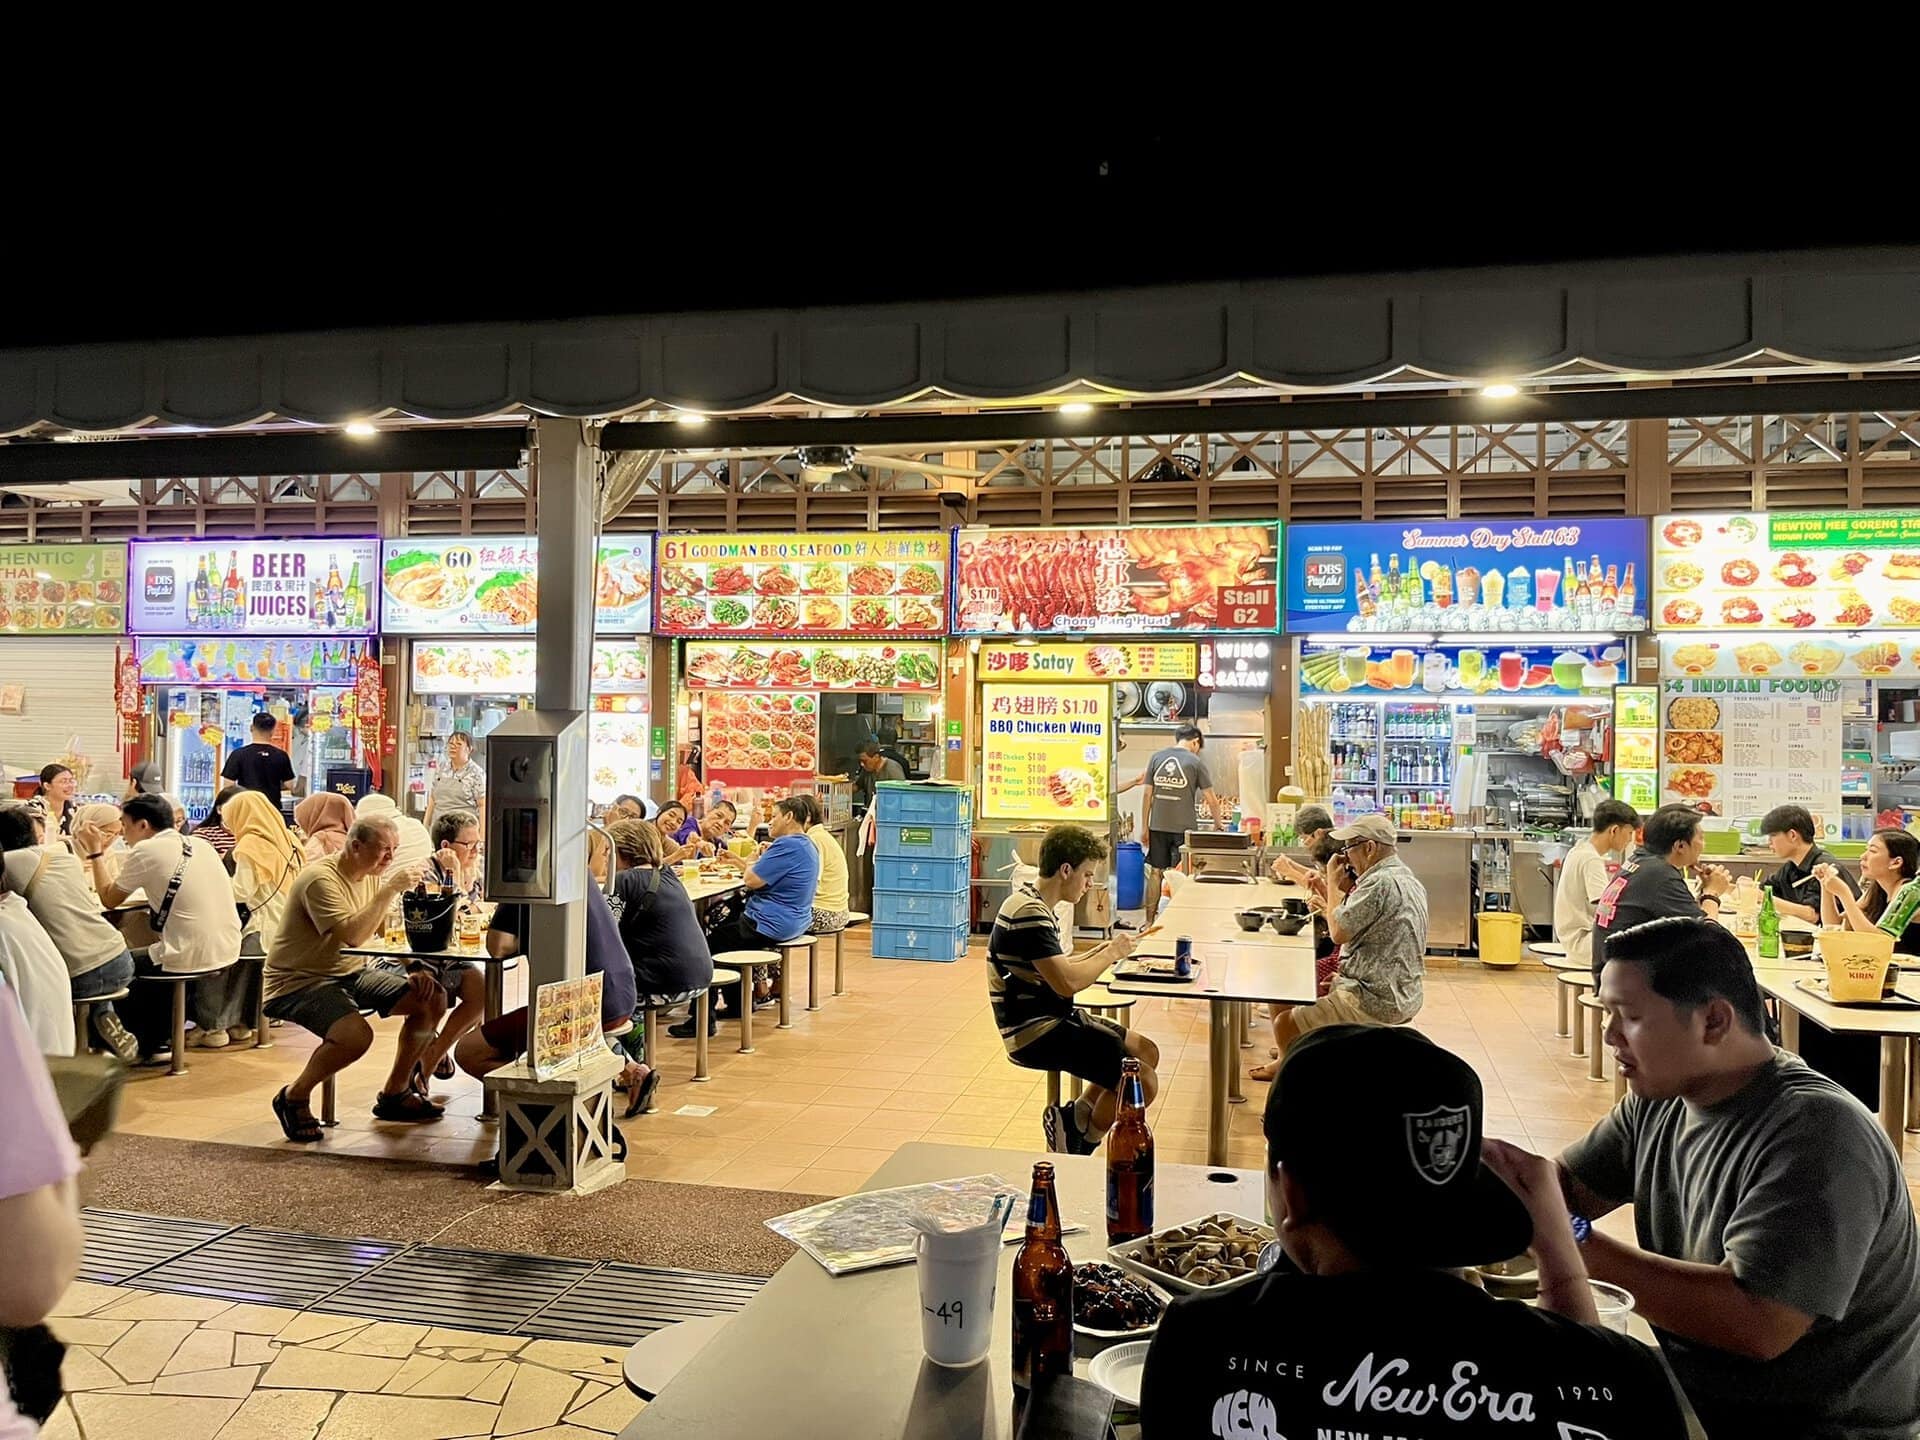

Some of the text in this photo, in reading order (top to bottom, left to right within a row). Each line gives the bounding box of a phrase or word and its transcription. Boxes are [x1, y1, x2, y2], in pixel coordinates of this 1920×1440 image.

[1825, 520, 1848, 530] MEE
[1403, 527, 1580, 551] Summer Day Stall 63
[665, 541, 688, 559] 61
[692, 544, 757, 557] GOODMAN
[760, 544, 787, 557] BBQ
[790, 543, 852, 557] SEAFOOD
[252, 553, 306, 578] BEER
[446, 551, 472, 568] 60
[1318, 564, 1342, 575] DBS
[274, 580, 283, 592] &
[970, 588, 998, 601] $1.70
[1223, 589, 1269, 605] Stall
[249, 596, 306, 616] JUICES
[1054, 615, 1097, 628] Chong
[1233, 608, 1258, 624] 62
[1033, 652, 1074, 674] Satay
[1215, 671, 1269, 687] SATAY
[1692, 680, 1760, 693] INDIAN
[1769, 680, 1823, 693] FOOD
[911, 701, 922, 714] B
[992, 696, 1098, 715] 鸡翅膀 $1.70
[990, 720, 1101, 735] BBQ Chicken Wing
[1416, 1113, 1464, 1128] RAIDERS
[1228, 1356, 1305, 1379] SINCE
[1322, 1352, 1536, 1422] New Era
[1557, 1386, 1613, 1401] 1920
